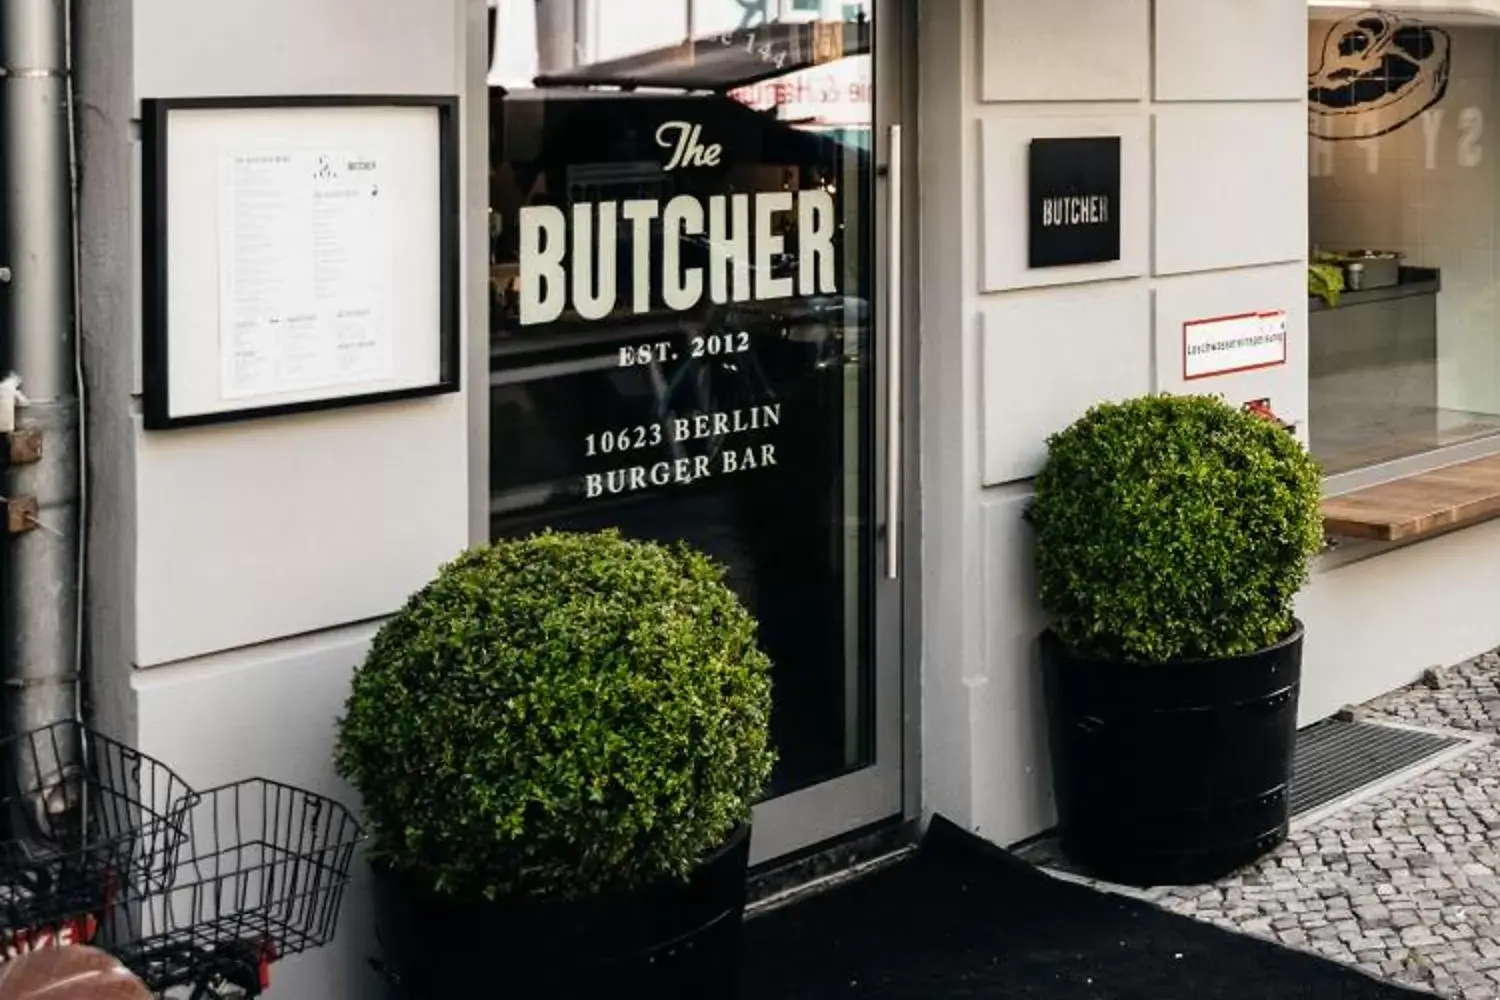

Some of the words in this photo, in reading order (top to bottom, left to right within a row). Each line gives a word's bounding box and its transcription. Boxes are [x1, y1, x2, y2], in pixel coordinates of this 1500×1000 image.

[655, 120, 723, 171] The
[1043, 195, 1109, 227] BUTCHER
[519, 189, 837, 326] BUTCHER
[618, 341, 678, 368] EST.
[691, 331, 750, 358] 2012
[584, 423, 662, 456] 10623
[673, 403, 781, 442] BERLIN
[585, 455, 711, 498] BURGER
[722, 443, 778, 474] BAR
